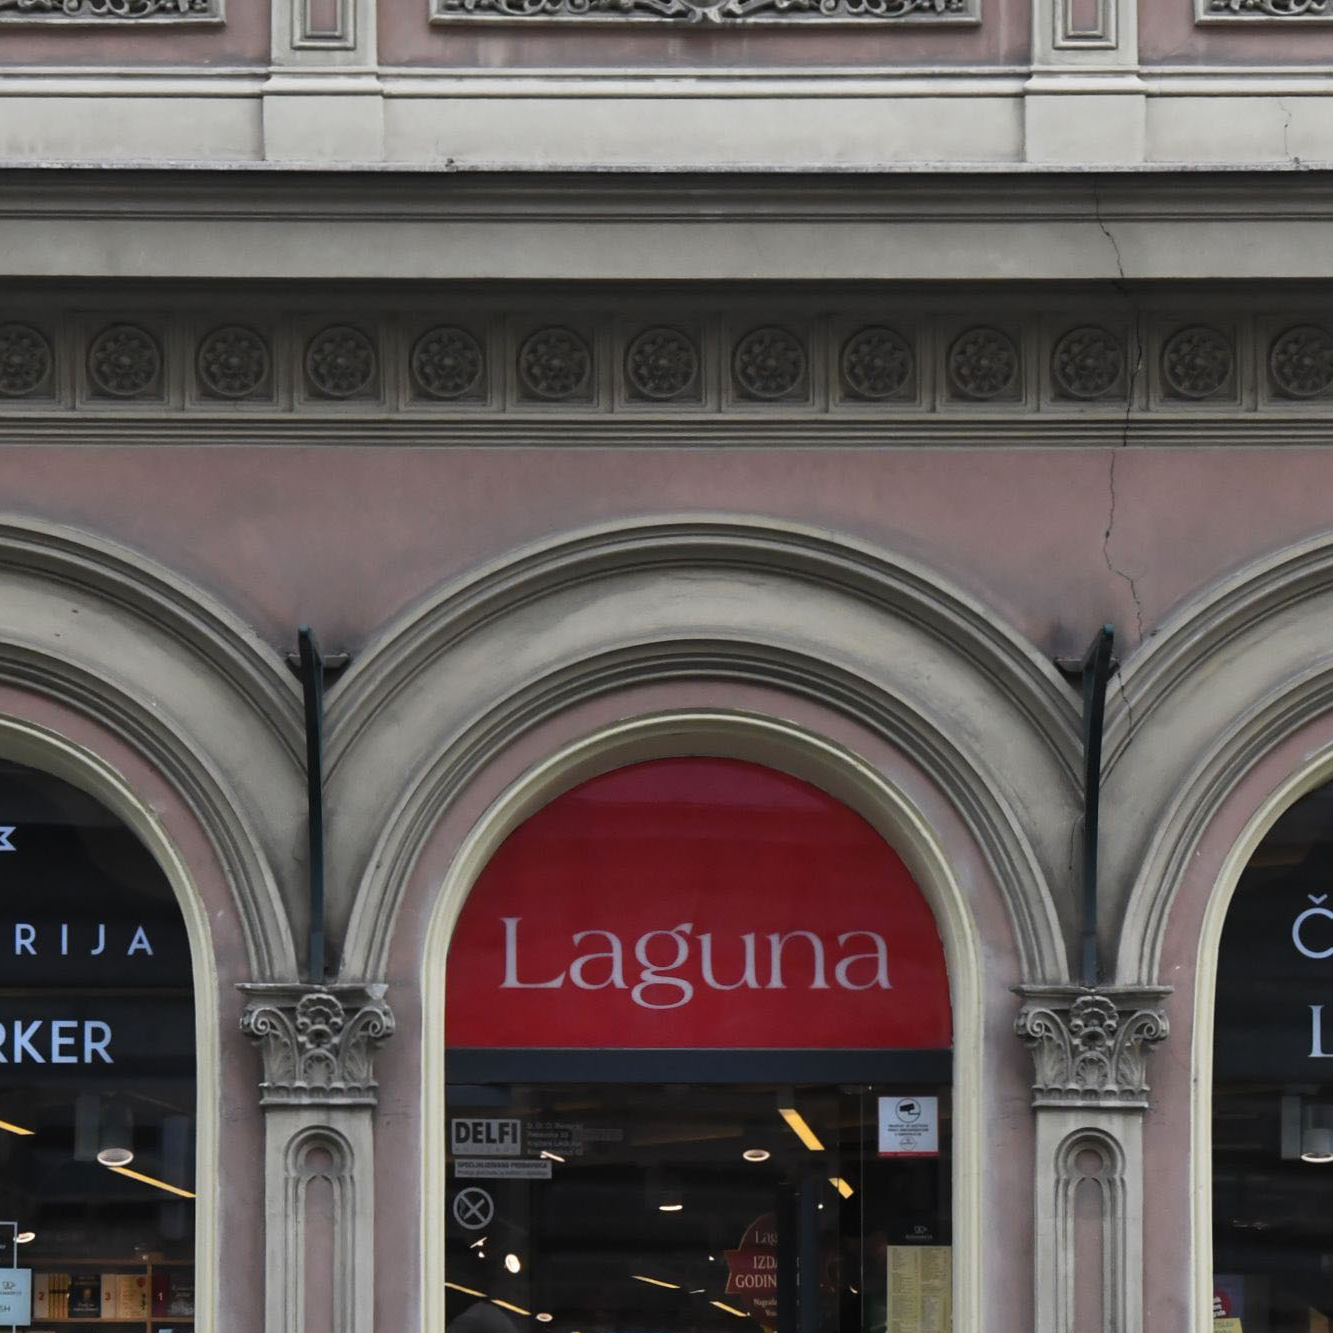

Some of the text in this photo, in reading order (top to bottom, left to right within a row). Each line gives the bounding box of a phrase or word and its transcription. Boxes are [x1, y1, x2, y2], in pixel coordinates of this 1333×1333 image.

[499, 917, 892, 1009] Laguna
[455, 1122, 517, 1144] DELFI
[735, 1274, 777, 1288] GODIN
